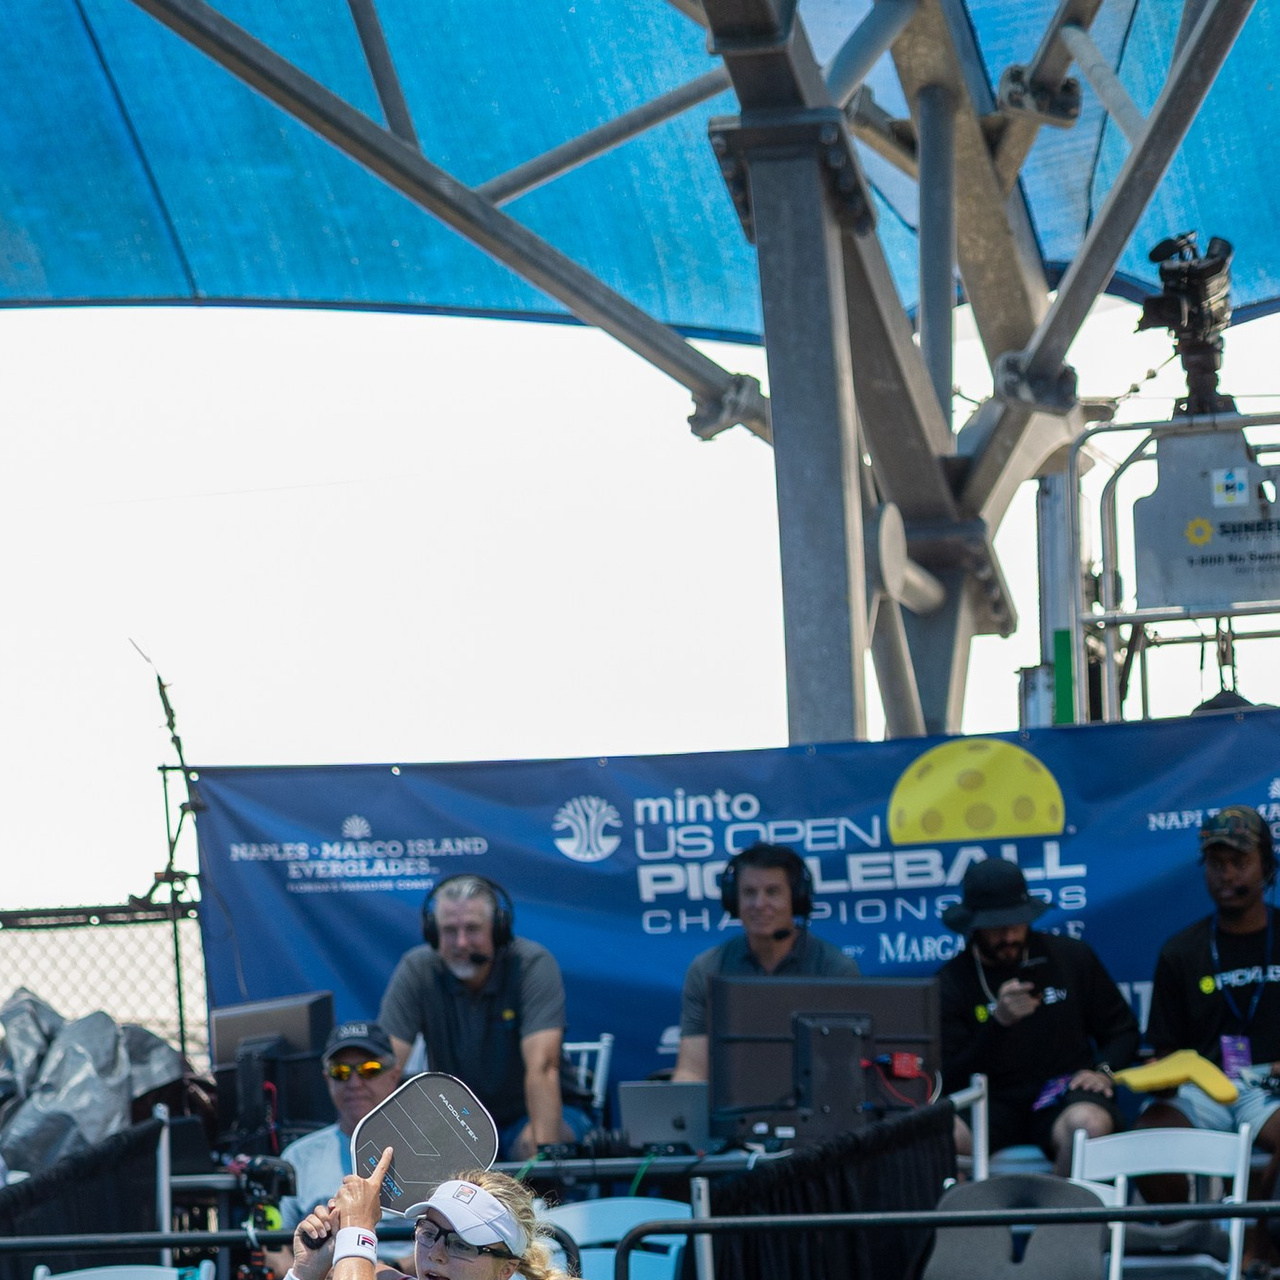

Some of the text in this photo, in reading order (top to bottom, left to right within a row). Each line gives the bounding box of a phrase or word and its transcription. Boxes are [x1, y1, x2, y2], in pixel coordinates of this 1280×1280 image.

[634, 788, 761, 826] minto
[229, 836, 489, 861] NAPLES MARCO ISLAND
[634, 814, 882, 861] US OPEN
[287, 857, 431, 879] EVERGLADES
[438, 1093, 479, 1142] PADDLETEK
